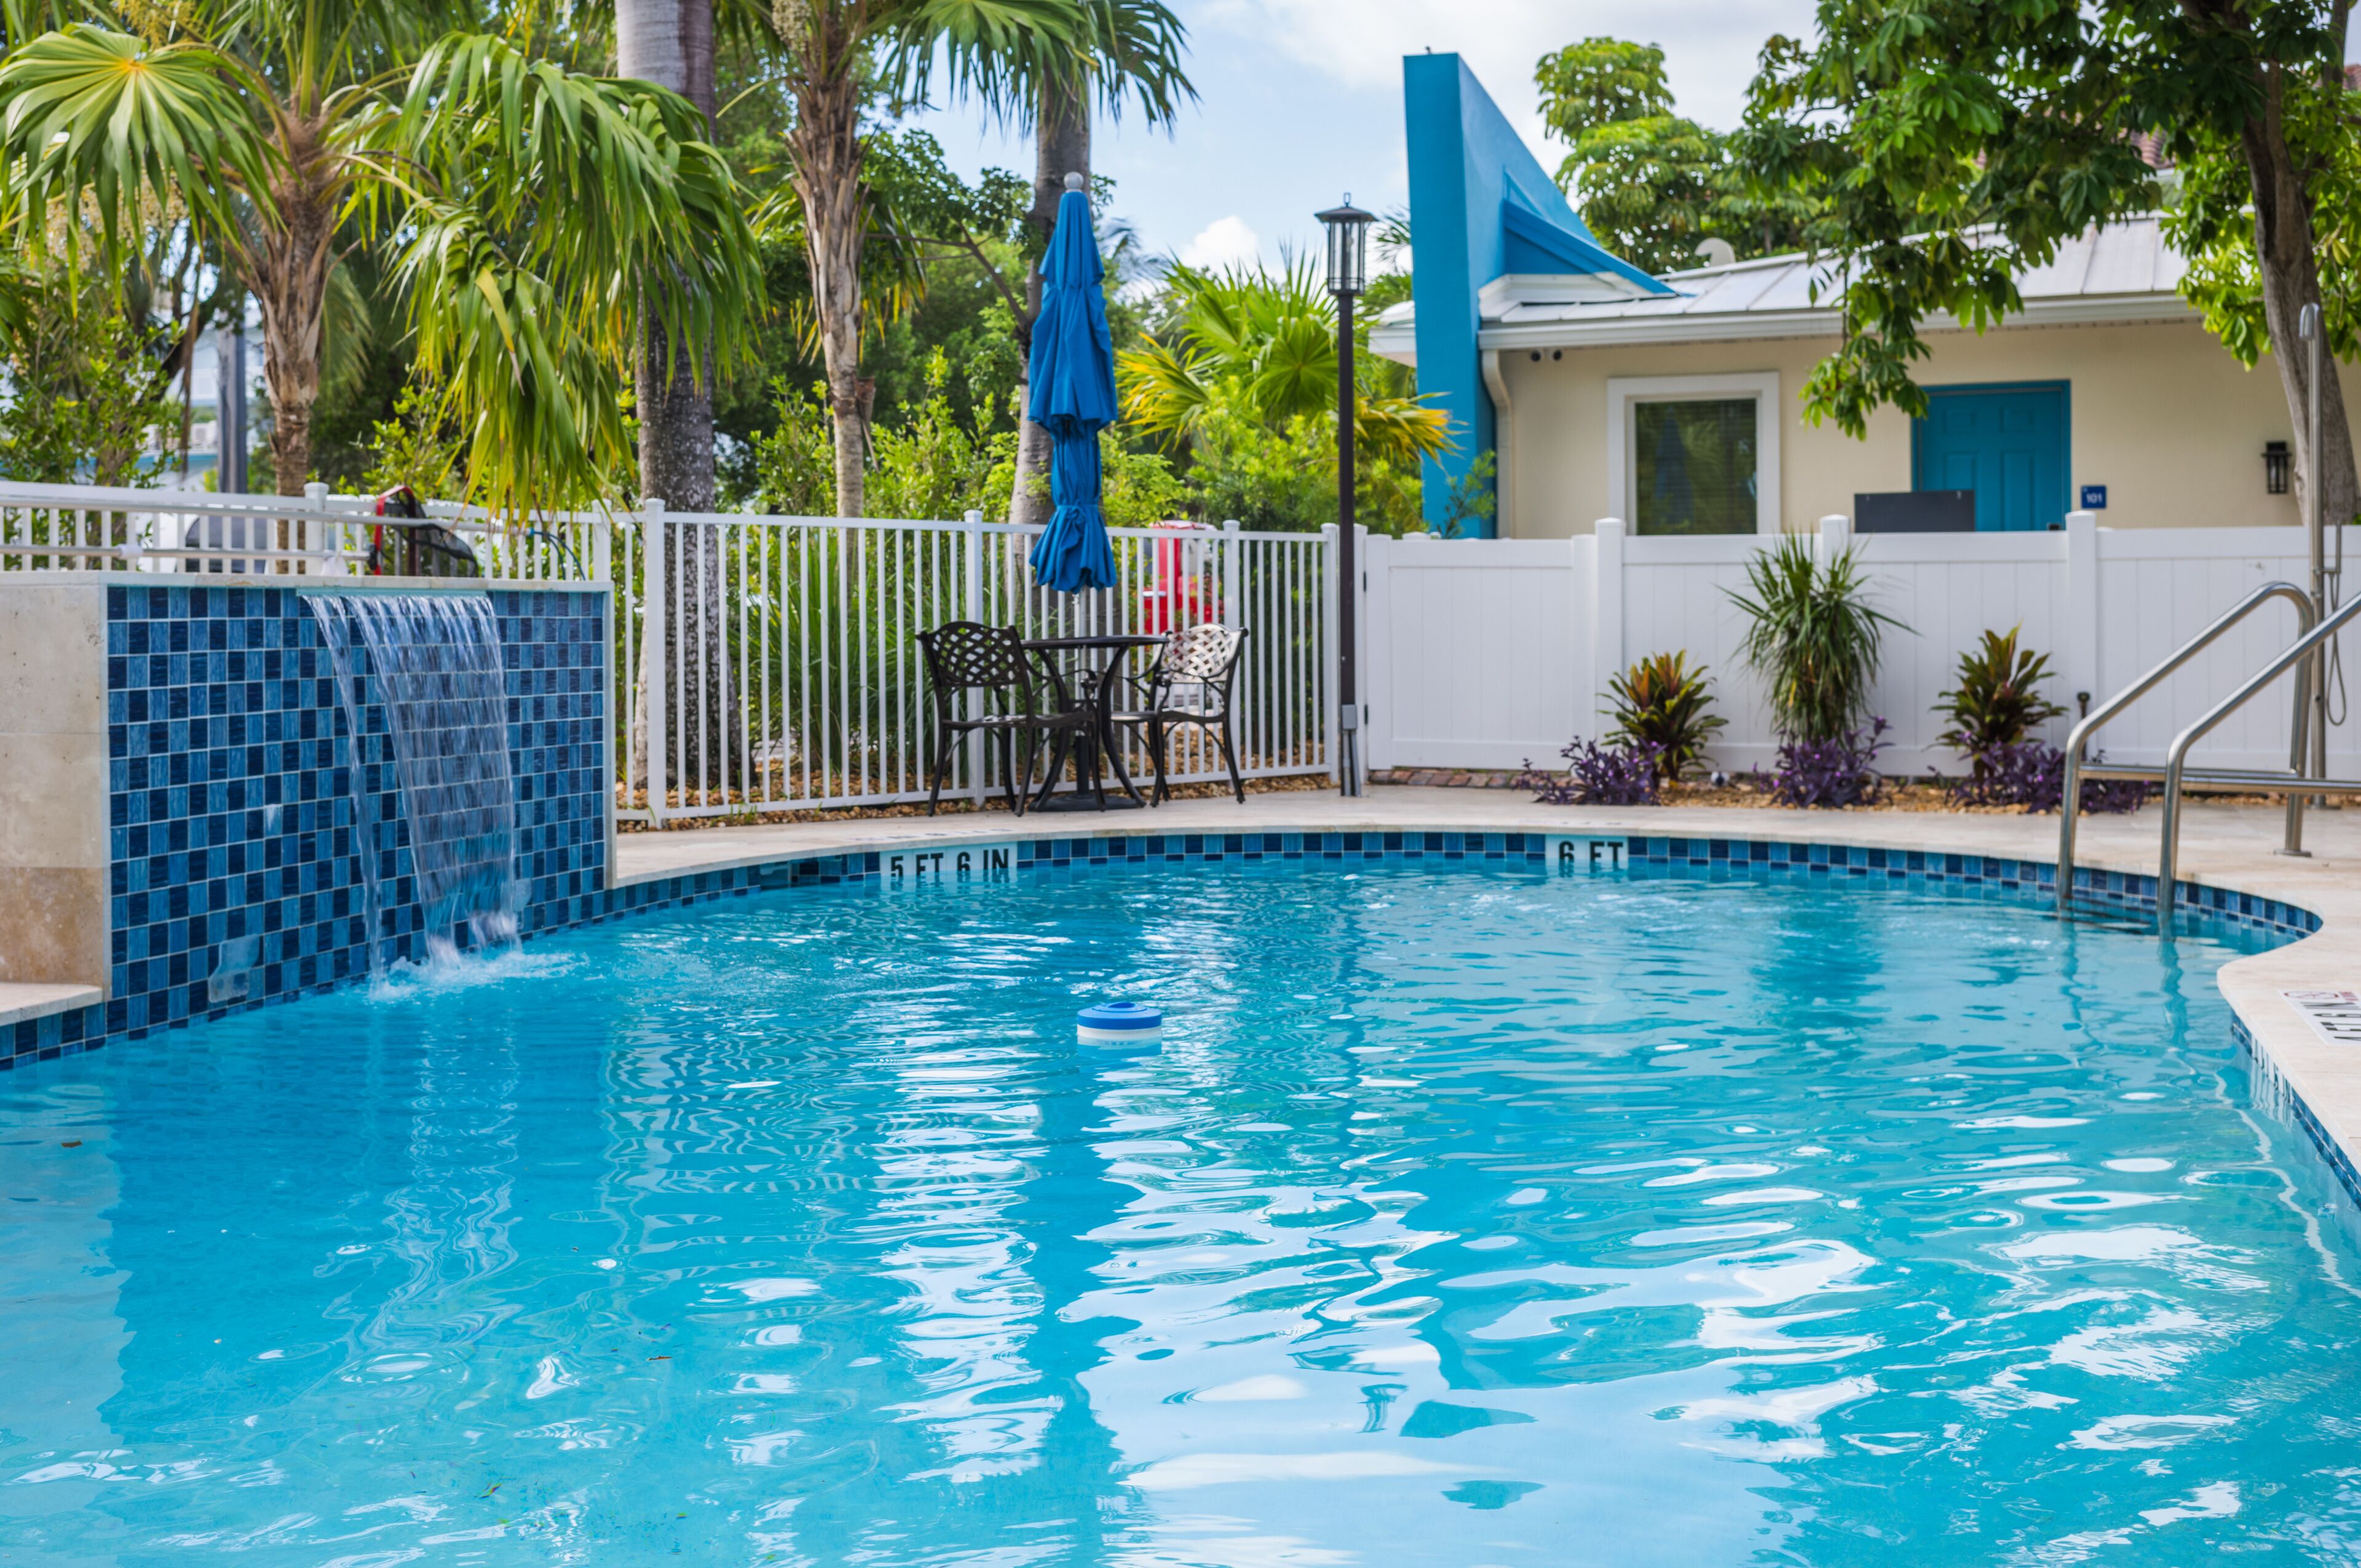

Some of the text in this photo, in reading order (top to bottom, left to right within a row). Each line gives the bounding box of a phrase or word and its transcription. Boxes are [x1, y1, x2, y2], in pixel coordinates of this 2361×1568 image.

[2086, 492, 2103, 504] 101
[890, 848, 1009, 876] 5 FT 6 IN
[1559, 840, 1624, 862] 6 FT
